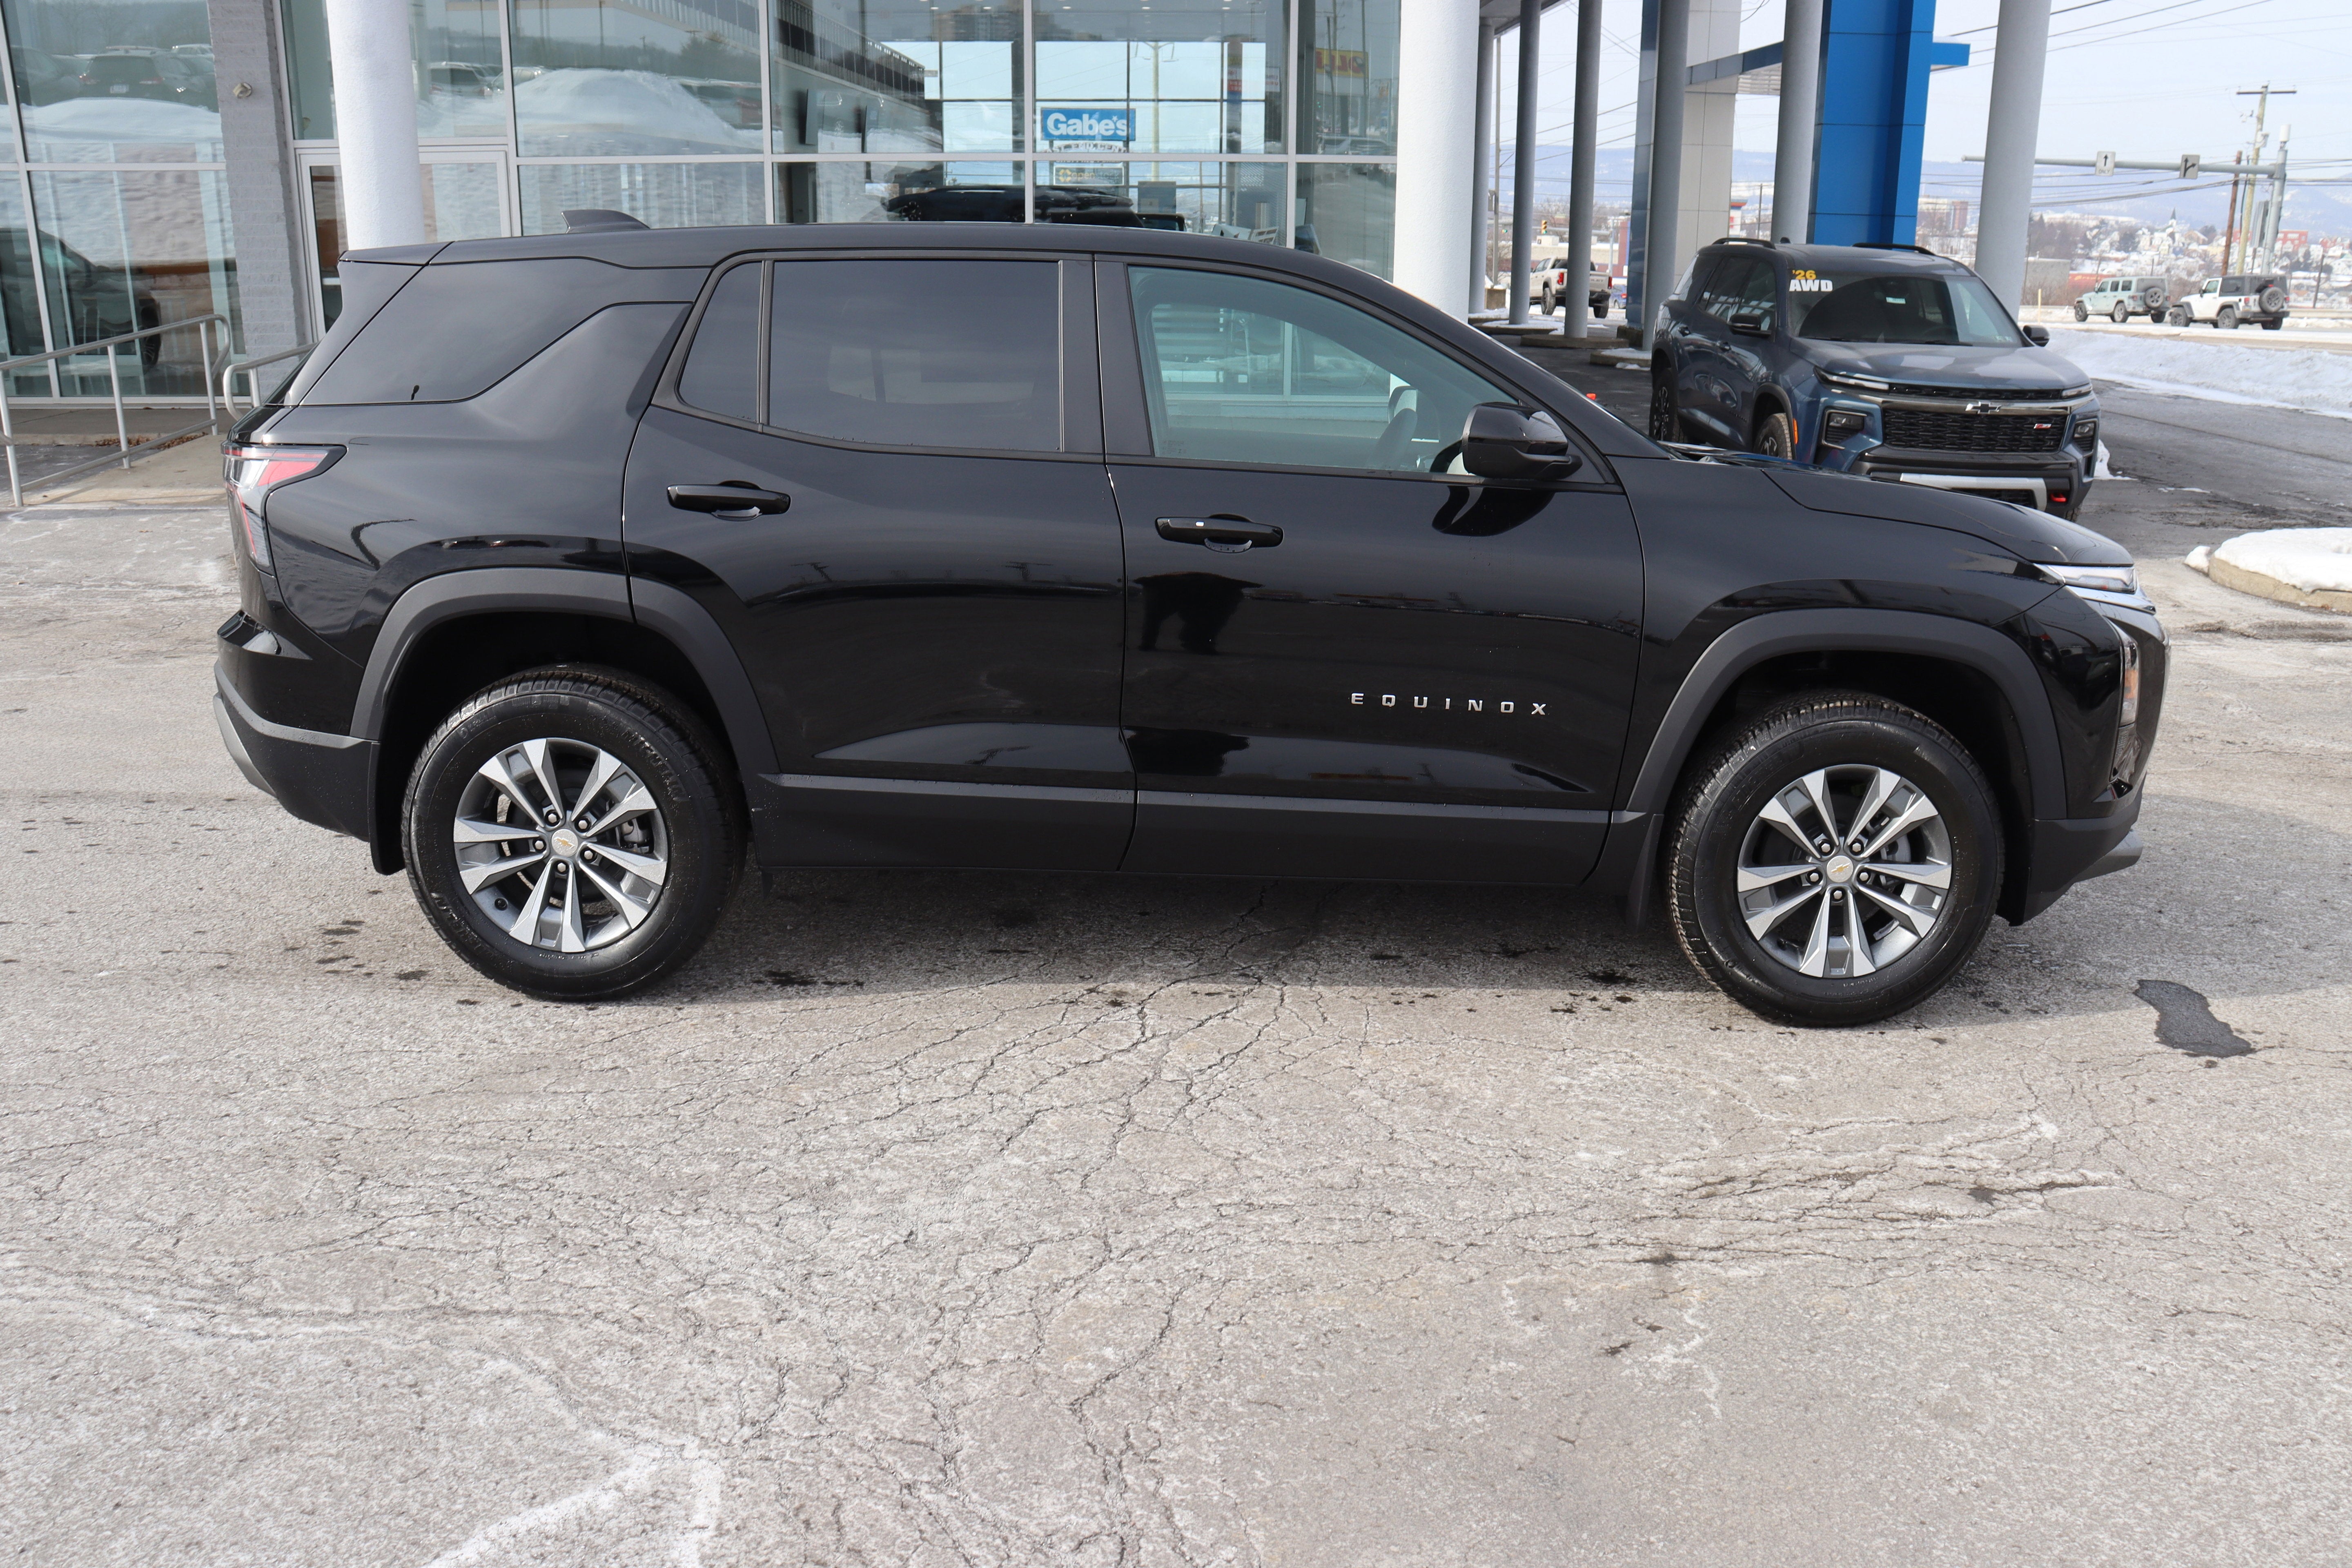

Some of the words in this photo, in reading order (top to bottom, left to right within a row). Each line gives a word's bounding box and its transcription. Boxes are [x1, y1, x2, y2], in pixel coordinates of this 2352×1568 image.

[1042, 144, 1067, 152] AST
[1792, 270, 1816, 280] '26
[1789, 279, 1833, 292] AWD
[1351, 693, 1547, 715] EQUINOX
